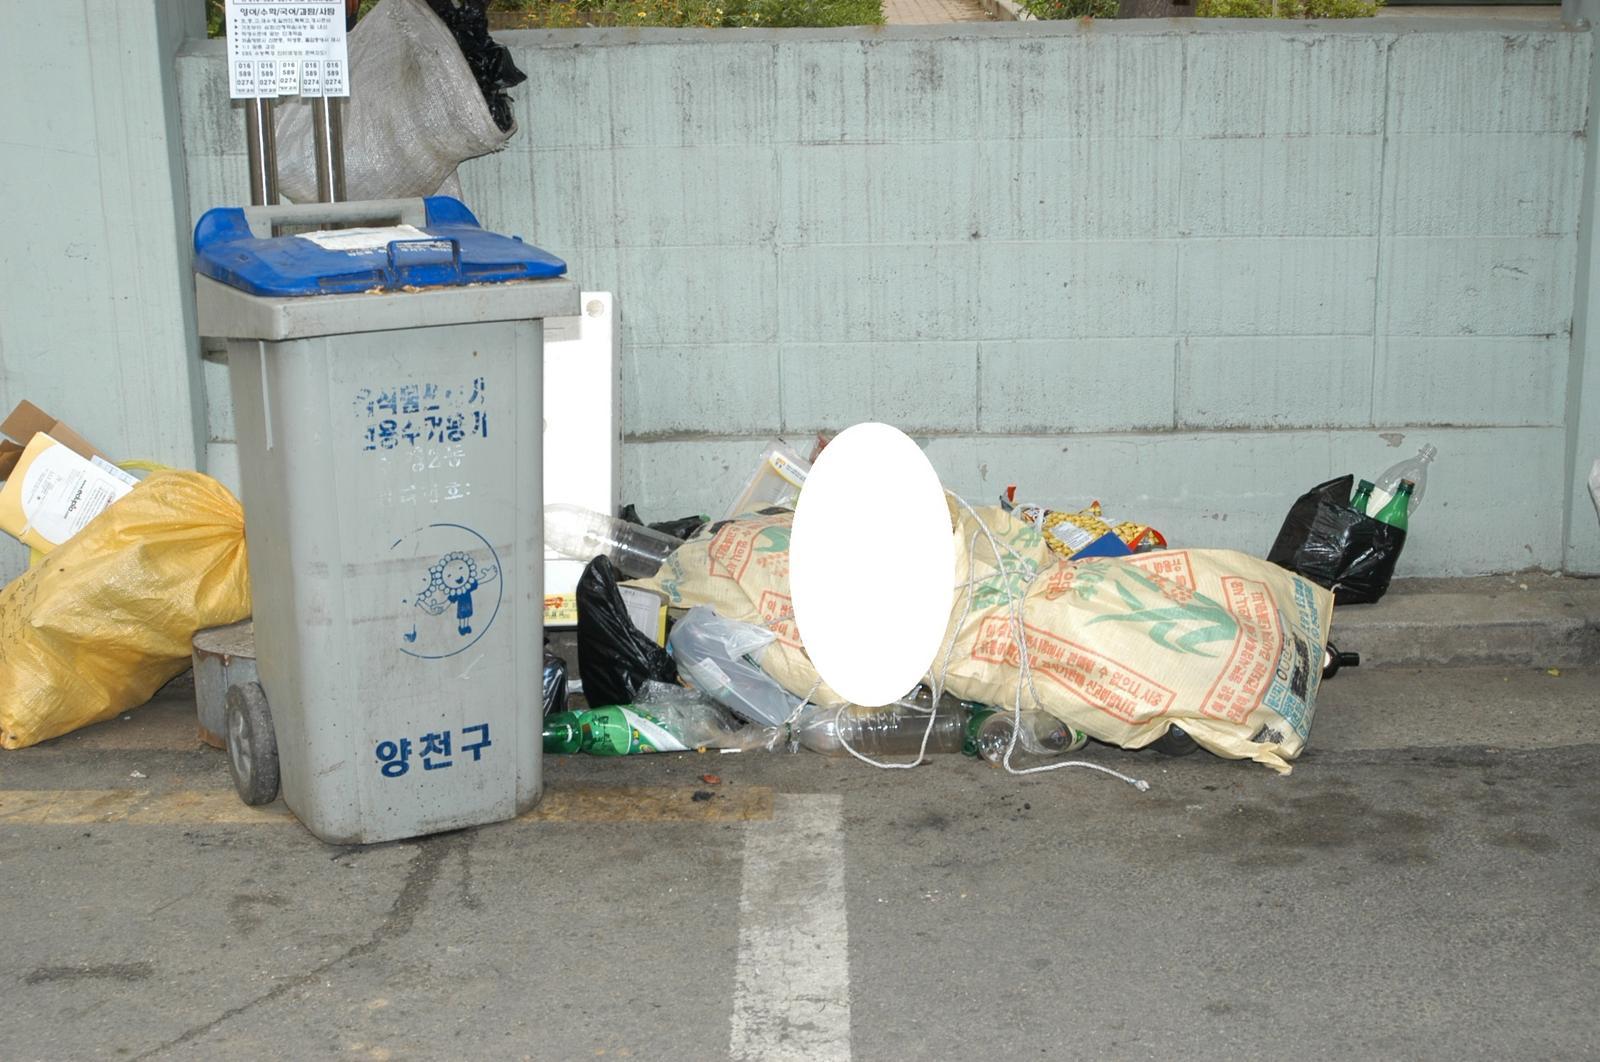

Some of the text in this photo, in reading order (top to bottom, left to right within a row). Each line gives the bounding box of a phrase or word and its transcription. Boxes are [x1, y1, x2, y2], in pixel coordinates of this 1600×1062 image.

[239, 62, 251, 70] 016
[261, 62, 274, 70] 016
[1099, 665, 1109, 678] 수
[1109, 671, 1141, 699] 없으니,
[1141, 689, 1164, 708] 시중
[376, 723, 492, 777] 양천구
